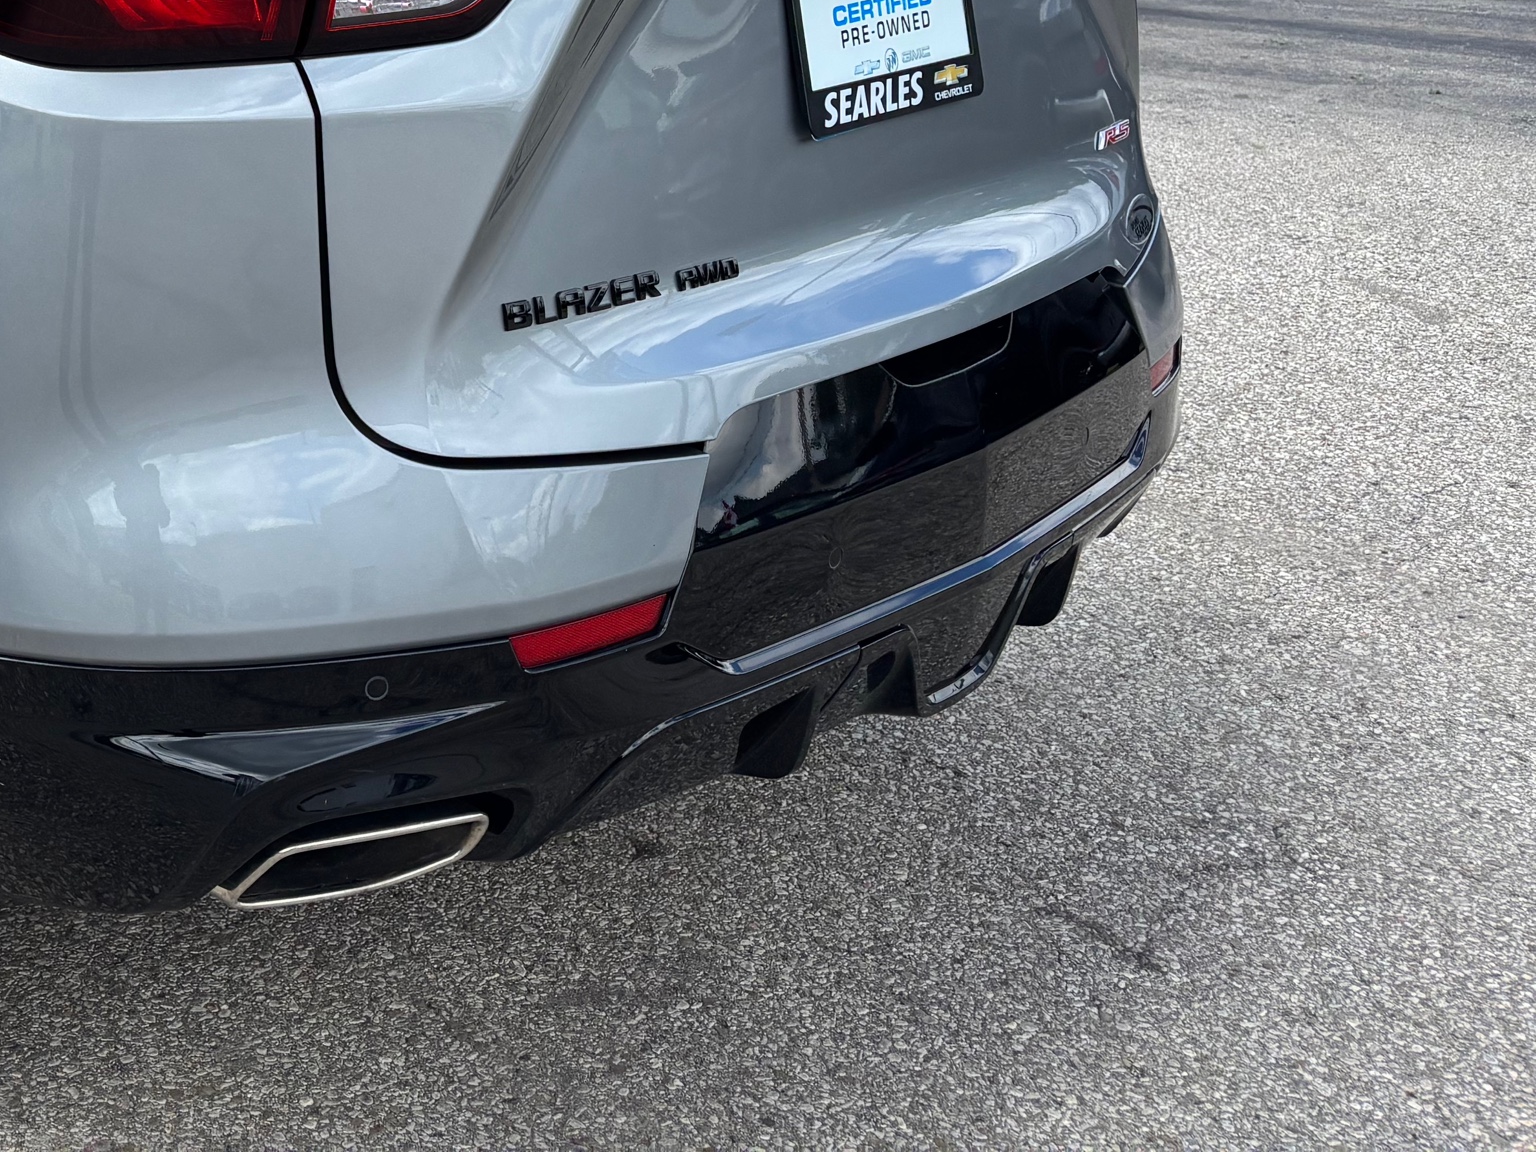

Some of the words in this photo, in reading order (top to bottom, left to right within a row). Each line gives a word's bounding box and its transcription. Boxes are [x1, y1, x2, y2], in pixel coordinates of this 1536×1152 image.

[841, 10, 931, 49] PRE-OWNED
[902, 46, 931, 64] GMC
[824, 70, 924, 128] SEARLES
[934, 83, 973, 101] CHEVROLET
[1103, 119, 1131, 149] RS
[501, 269, 662, 332] BLAZER
[673, 256, 740, 292] AWD
